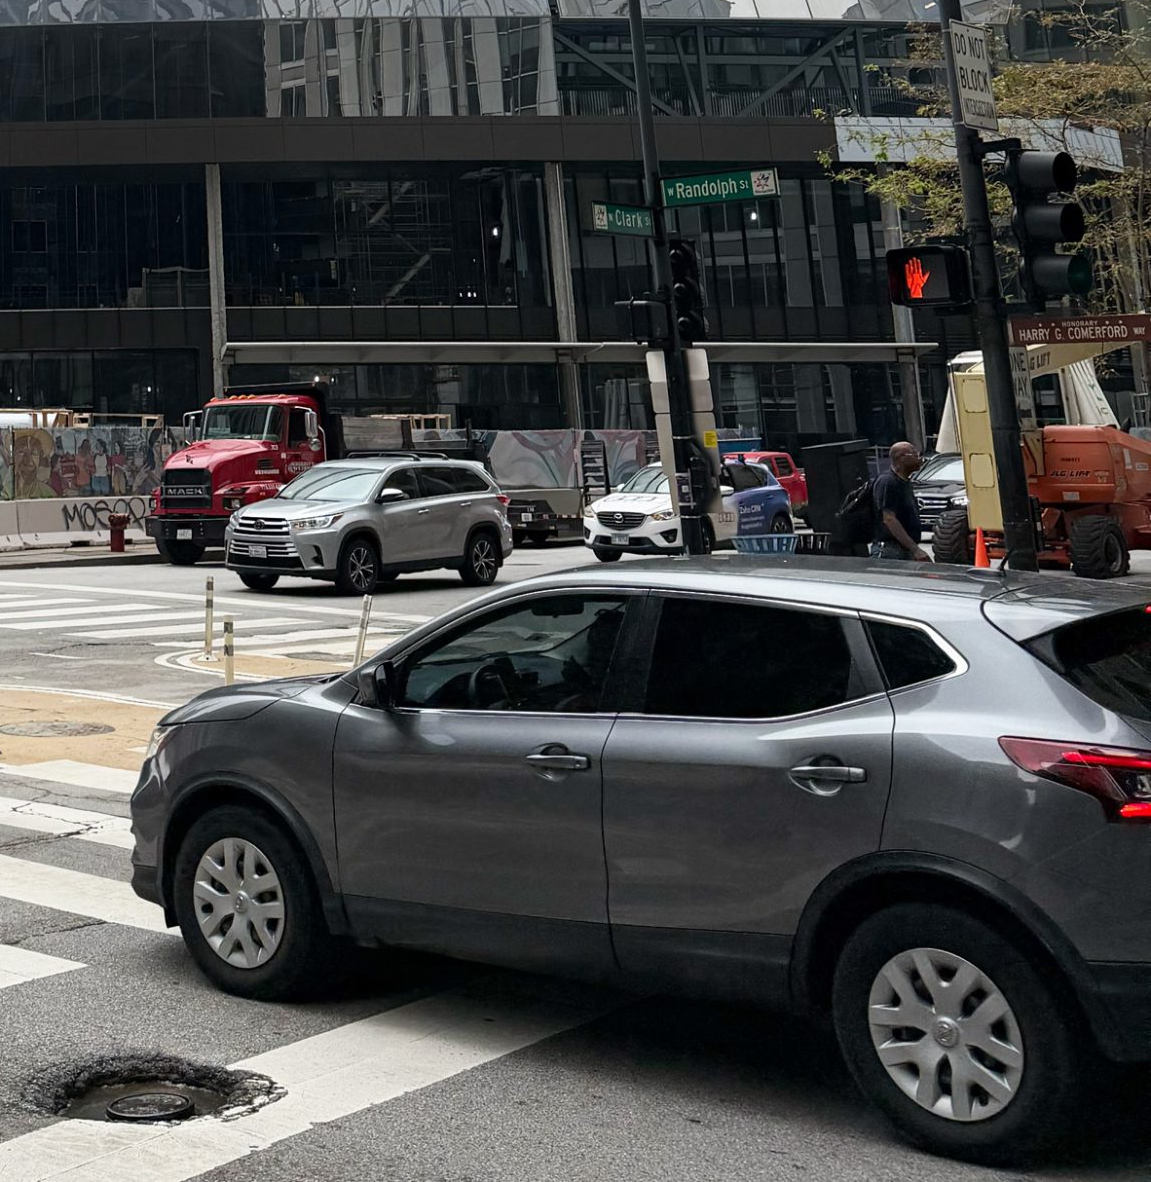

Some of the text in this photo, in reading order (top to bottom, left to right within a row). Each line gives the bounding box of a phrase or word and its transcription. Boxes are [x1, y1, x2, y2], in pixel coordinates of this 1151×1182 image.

[954, 32, 985, 60] DO NOT
[959, 66, 990, 94] BLOCK
[667, 178, 749, 198] W Randolph St
[615, 210, 643, 228] Clark
[1019, 329, 1050, 341] HARRY
[1067, 326, 1128, 340] COMERFORD
[1133, 326, 1145, 335] WAY
